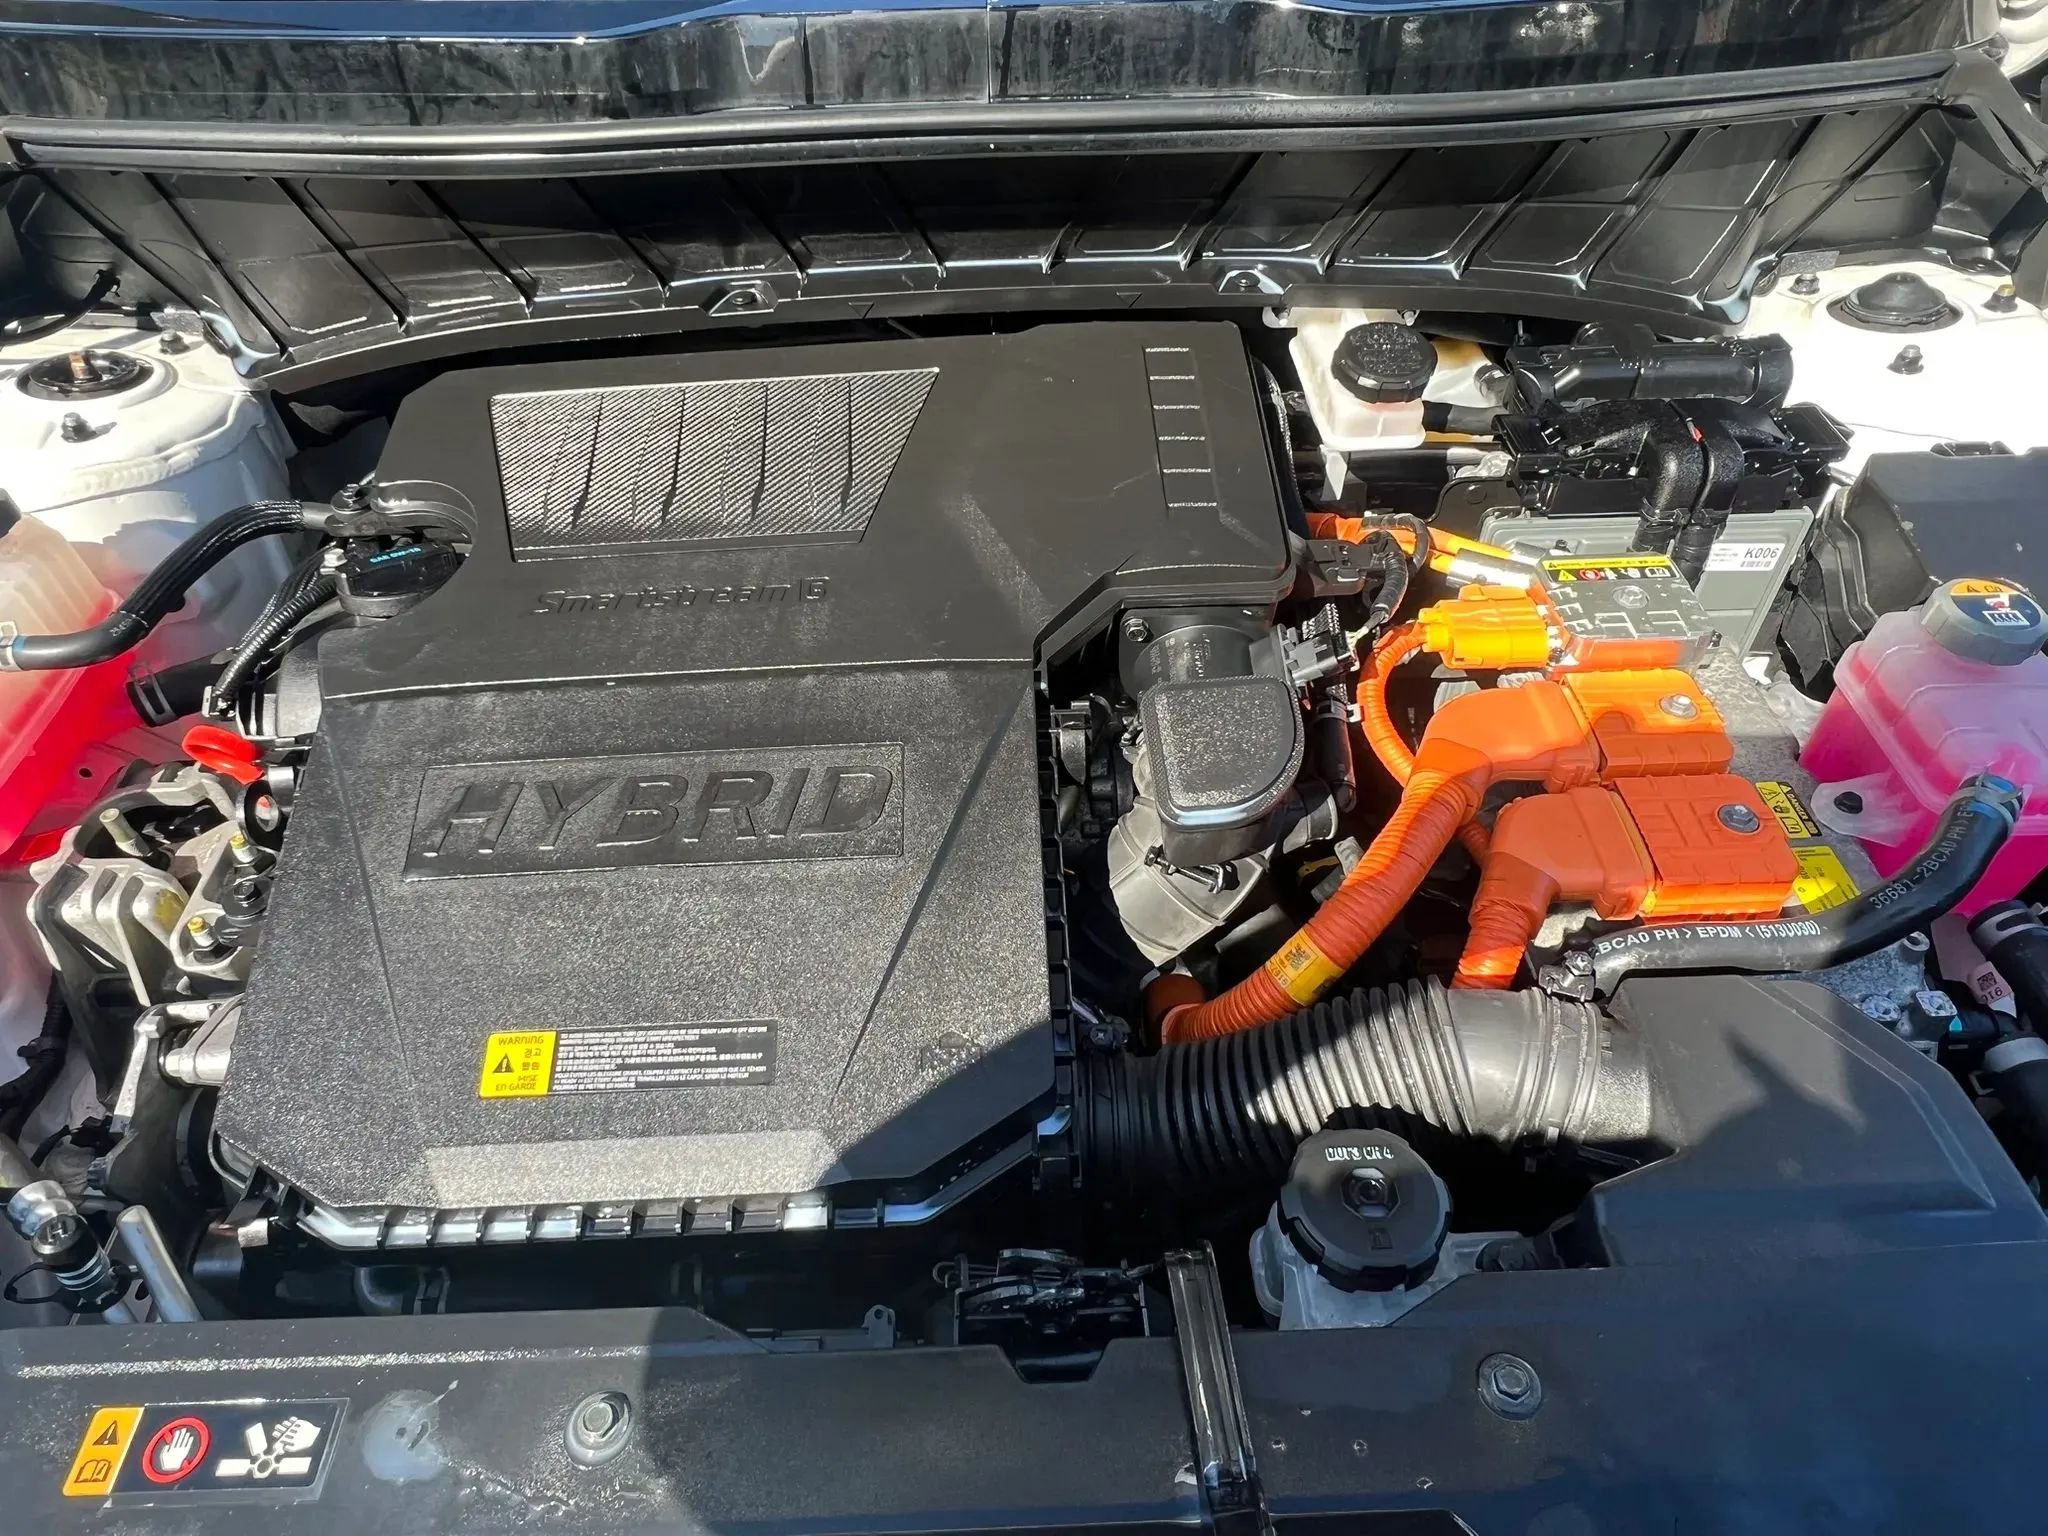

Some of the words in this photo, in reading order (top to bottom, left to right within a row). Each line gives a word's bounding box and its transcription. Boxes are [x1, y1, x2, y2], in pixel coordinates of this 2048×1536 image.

[1744, 547, 1779, 559] K006
[422, 766, 893, 857] HYBRID
[1597, 931, 1649, 955] BCA0
[1654, 928, 1678, 941] PH
[1699, 926, 1742, 938] EPDM
[498, 1035, 544, 1046] WARNING
[524, 1047, 542, 1059] 경고
